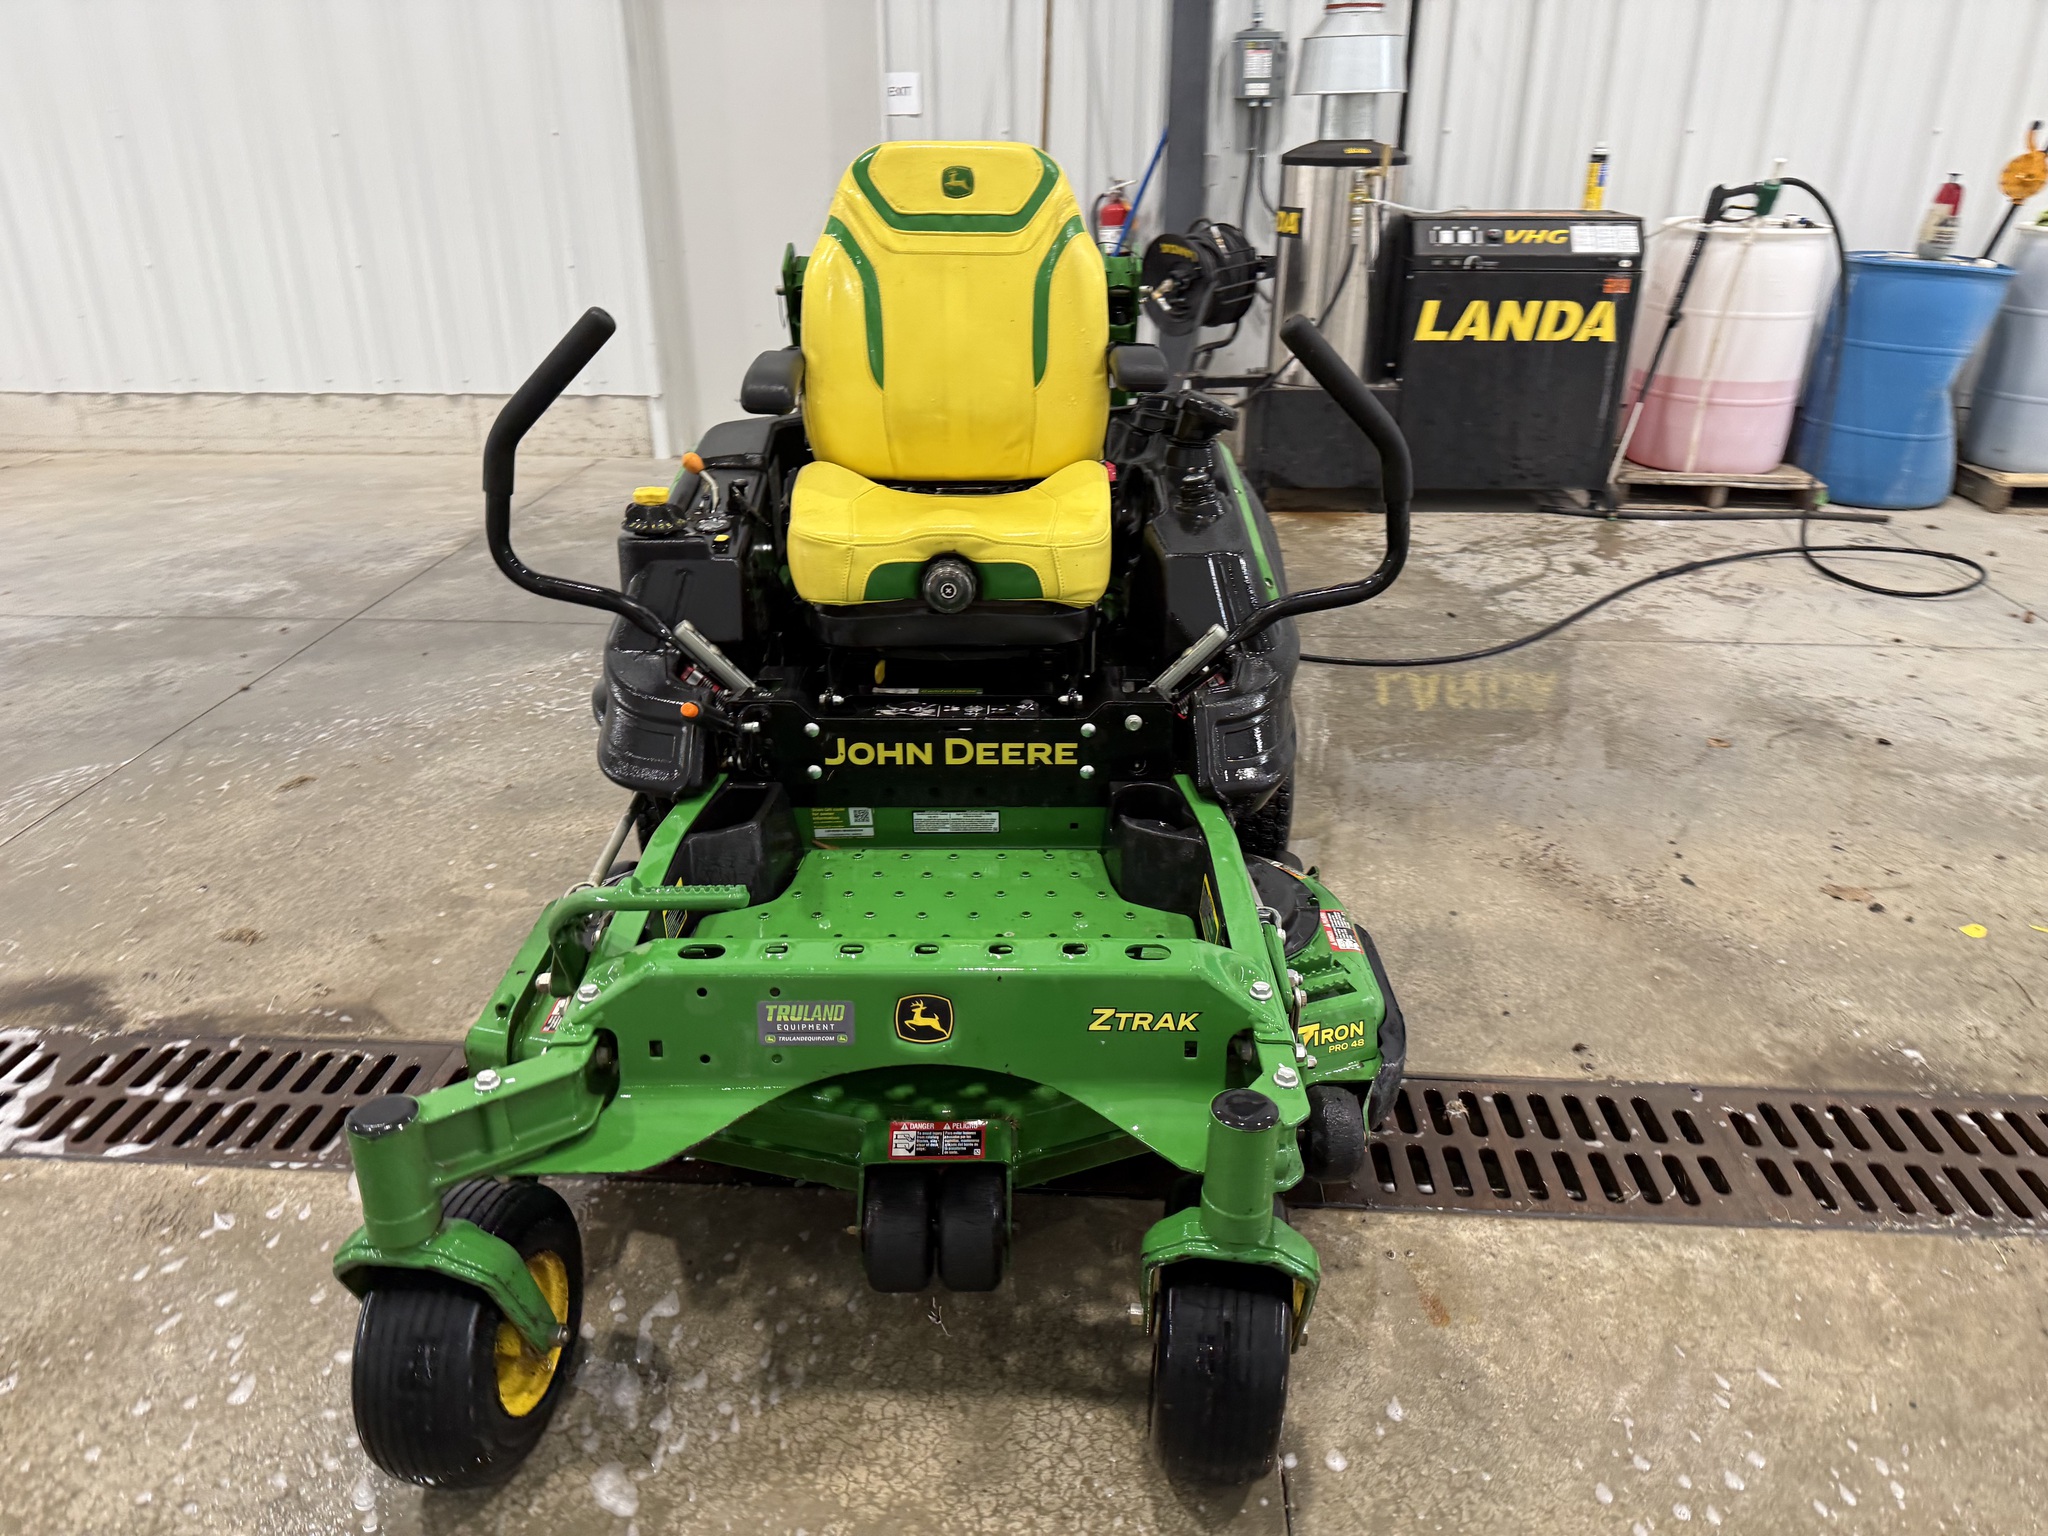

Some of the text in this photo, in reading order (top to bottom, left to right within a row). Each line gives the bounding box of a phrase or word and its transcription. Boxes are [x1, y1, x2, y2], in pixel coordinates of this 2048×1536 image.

[1504, 229, 1570, 244] VHG
[1413, 300, 1617, 342] LANDA
[825, 737, 1078, 765] JOHN DEERE
[766, 1005, 846, 1021] TRULAND
[1087, 1008, 1201, 1031] ZTRAK
[1328, 1038, 1365, 1053] PRO 48
[910, 1122, 935, 1130] DANGER
